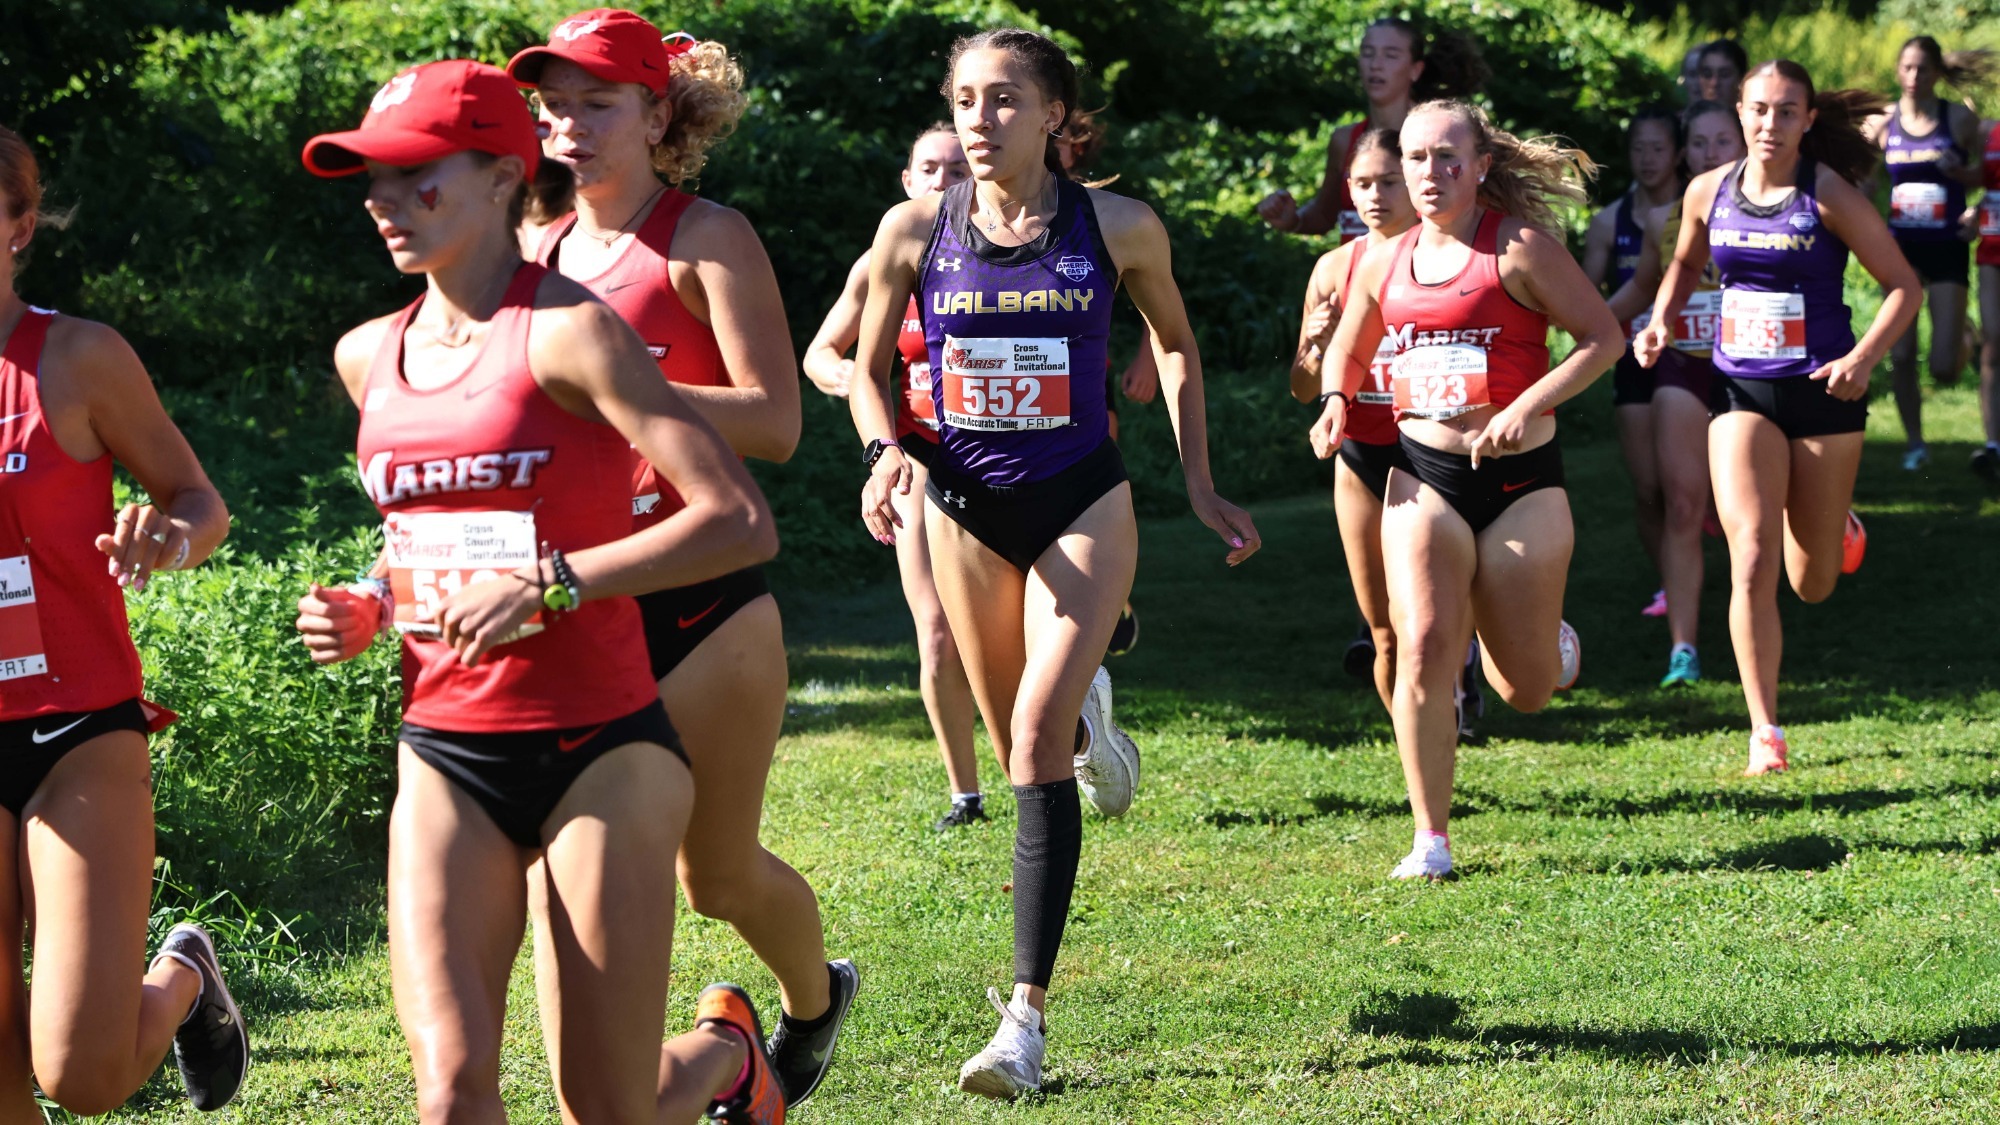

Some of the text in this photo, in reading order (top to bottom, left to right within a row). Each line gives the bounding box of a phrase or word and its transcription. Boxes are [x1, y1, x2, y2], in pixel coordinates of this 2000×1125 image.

[1710, 229, 1816, 251] UALBANY
[933, 289, 1094, 315] UALBANY
[1388, 322, 1502, 350] MARIST
[1684, 316, 1719, 340] 15
[1734, 319, 1786, 348] 563
[1014, 344, 1039, 352] Cross
[1014, 354, 1048, 363] Country
[950, 354, 1008, 370] MARIST
[1014, 362, 1066, 371] Invitational
[962, 377, 1042, 416] 552
[1409, 375, 1468, 409] 523
[949, 413, 967, 426] Fulton
[967, 416, 995, 428] Accurate
[996, 418, 1019, 429] Timing
[357, 450, 550, 505] MARIST
[412, 569, 500, 618] 51
